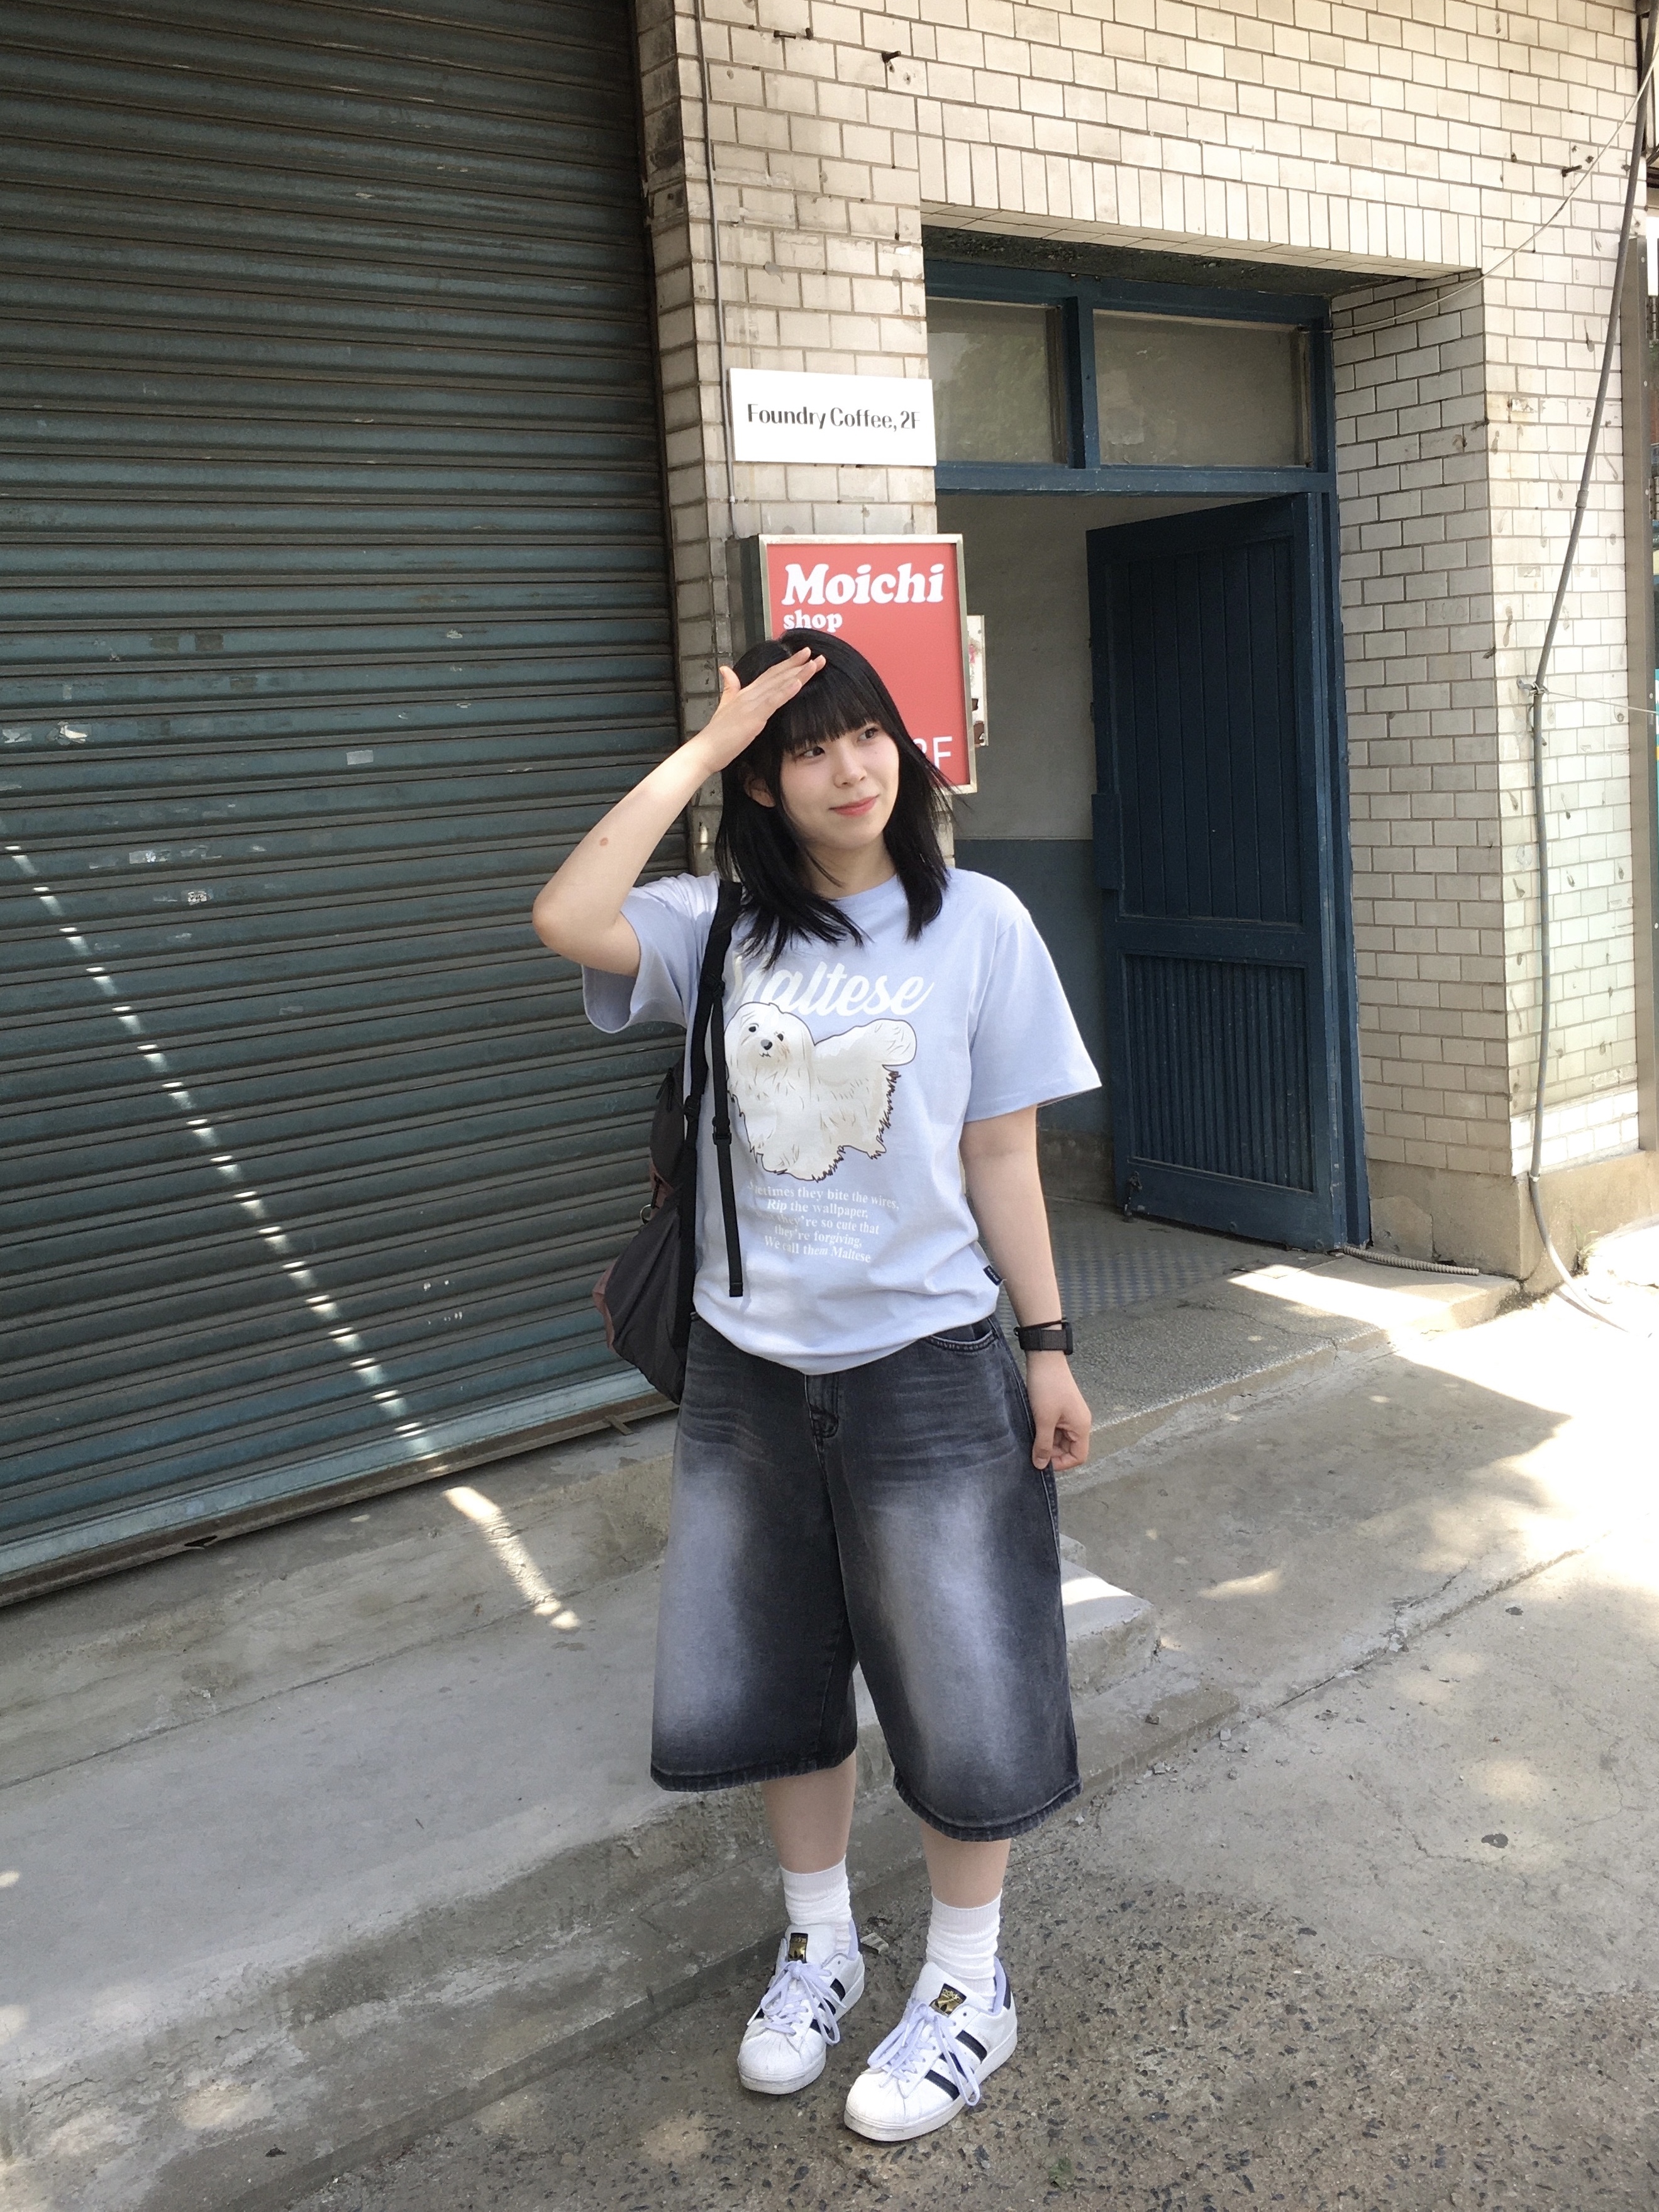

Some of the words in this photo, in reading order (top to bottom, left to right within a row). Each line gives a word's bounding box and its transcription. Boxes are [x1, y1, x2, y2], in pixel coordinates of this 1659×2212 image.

[747, 404, 826, 429] Foundry
[830, 407, 897, 432] Coffee,
[900, 410, 921, 429] 2F
[781, 563, 945, 606] Moichi
[783, 609, 843, 633] shop
[748, 1181, 794, 1197] etimes
[797, 1187, 823, 1202] they
[827, 1188, 850, 1202] bite
[852, 1191, 868, 1203] the
[871, 1195, 899, 1210] wires,
[767, 1198, 787, 1213] Rip
[790, 1200, 809, 1213] the
[812, 1203, 869, 1219] wallpaper,
[814, 1230, 863, 1249] forgiving,
[821, 1219, 833, 1228] so
[836, 1220, 857, 1232] cute
[859, 1221, 880, 1235] that
[764, 1235, 780, 1249] We
[782, 1241, 800, 1254] call
[802, 1244, 829, 1256] them
[831, 1246, 871, 1263] Maltese
